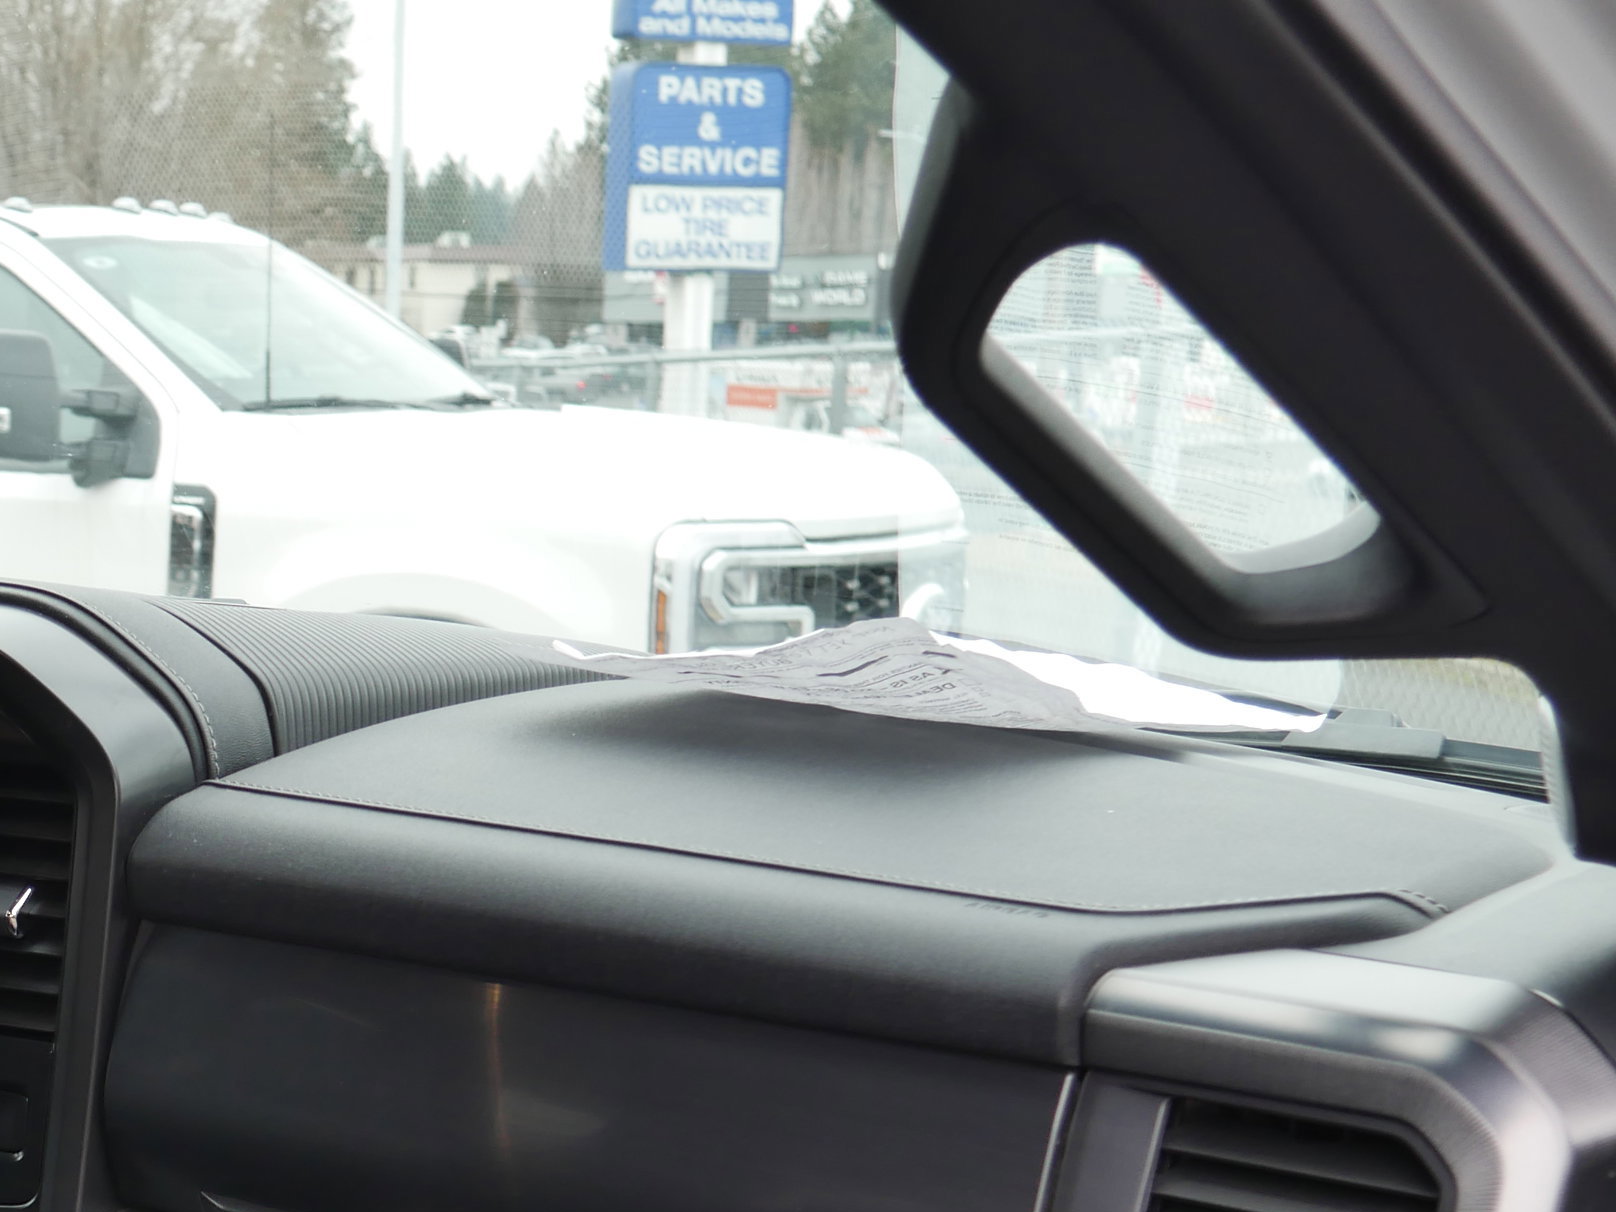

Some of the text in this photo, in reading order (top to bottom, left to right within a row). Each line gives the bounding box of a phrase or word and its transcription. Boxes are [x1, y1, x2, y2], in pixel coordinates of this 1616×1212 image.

[638, 15, 789, 41] and Models
[657, 75, 766, 108] PARTS
[697, 111, 722, 141] &
[637, 146, 781, 178] SERVICE
[641, 195, 769, 216] LOW PRICE
[682, 217, 729, 237] TIRE
[634, 240, 770, 262] GUARANTEE
